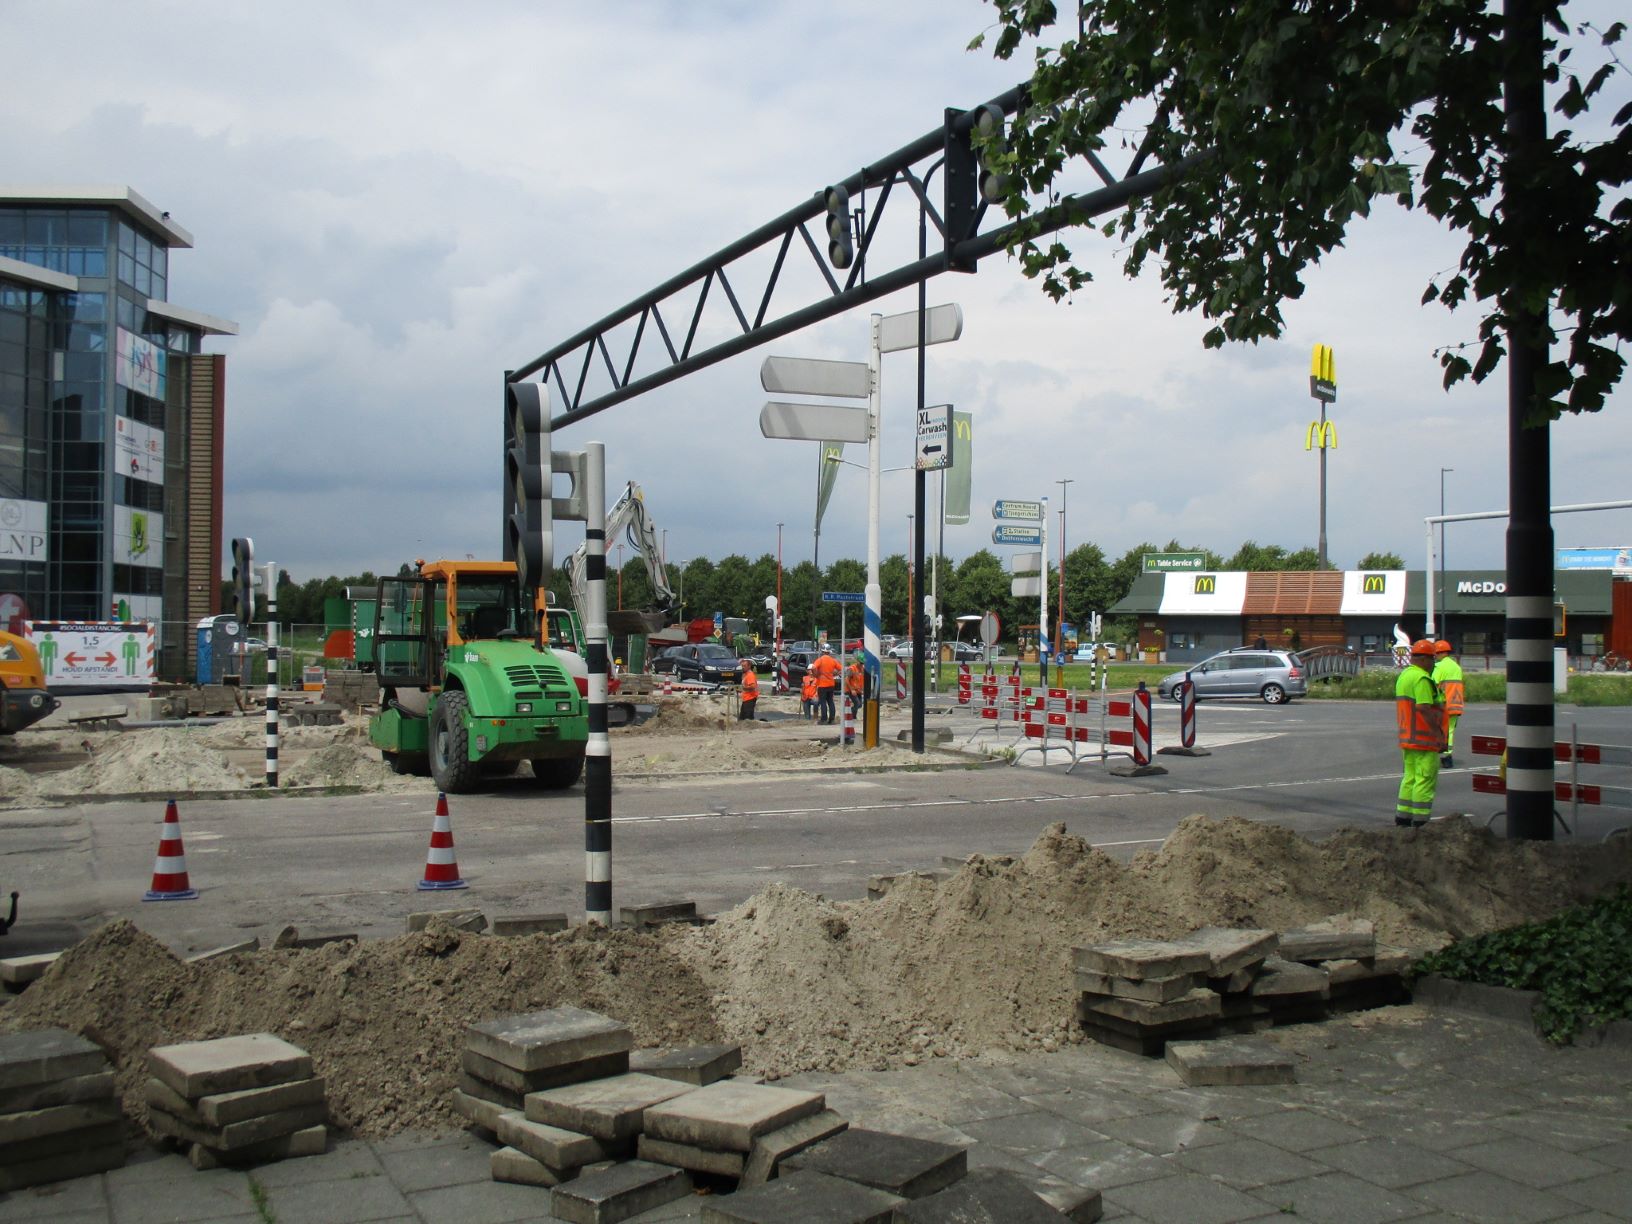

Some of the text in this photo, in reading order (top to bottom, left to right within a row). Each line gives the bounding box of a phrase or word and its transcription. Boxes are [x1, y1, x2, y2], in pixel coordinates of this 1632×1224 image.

[919, 411, 931, 425] XL
[918, 422, 947, 436] Carwash
[1157, 559, 1172, 567] Table
[1172, 559, 1192, 567] Service
[1457, 581, 1507, 594] McDo
[82, 636, 100, 646] 1.5
